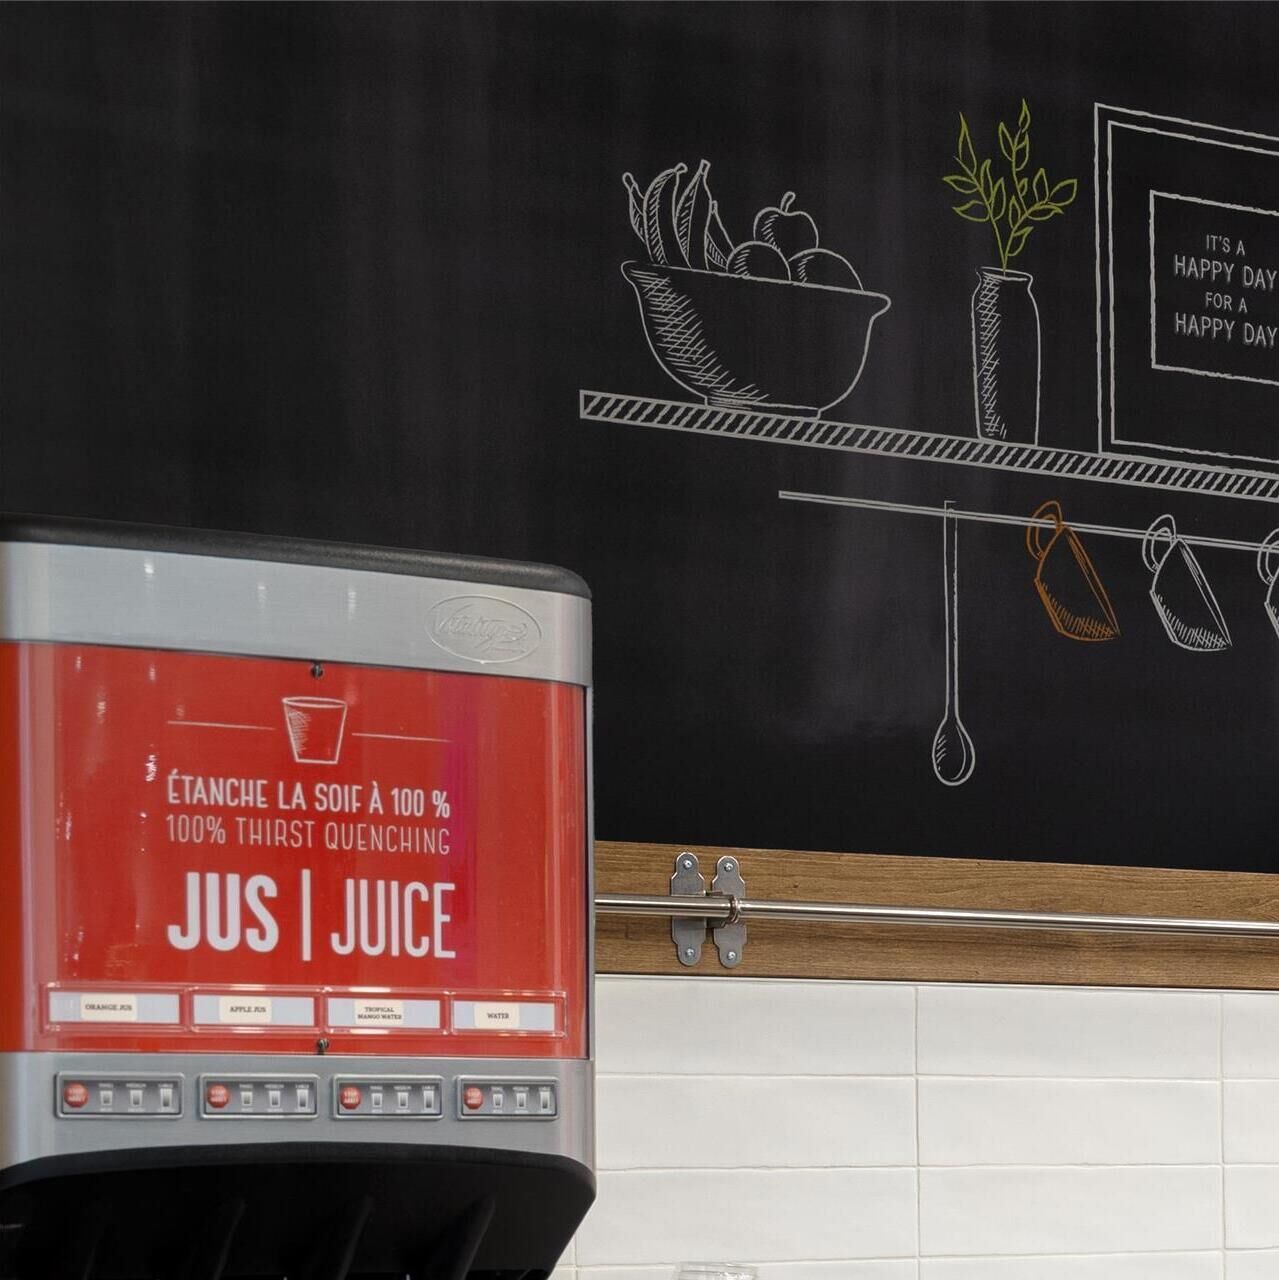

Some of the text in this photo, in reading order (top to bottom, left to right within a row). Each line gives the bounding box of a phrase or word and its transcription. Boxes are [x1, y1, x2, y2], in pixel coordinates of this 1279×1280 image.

[1205, 234, 1246, 256] IT'S A
[1173, 254, 1278, 292] HAPPY DAY
[1205, 291, 1248, 314] FOR A
[1174, 312, 1278, 349] HAPPY DAY
[167, 768, 451, 819] ÉTANCHE LA SOIF À 100 %
[166, 814, 451, 856] 100% THIRST QUENCHING
[167, 871, 457, 960] JUS JUICE
